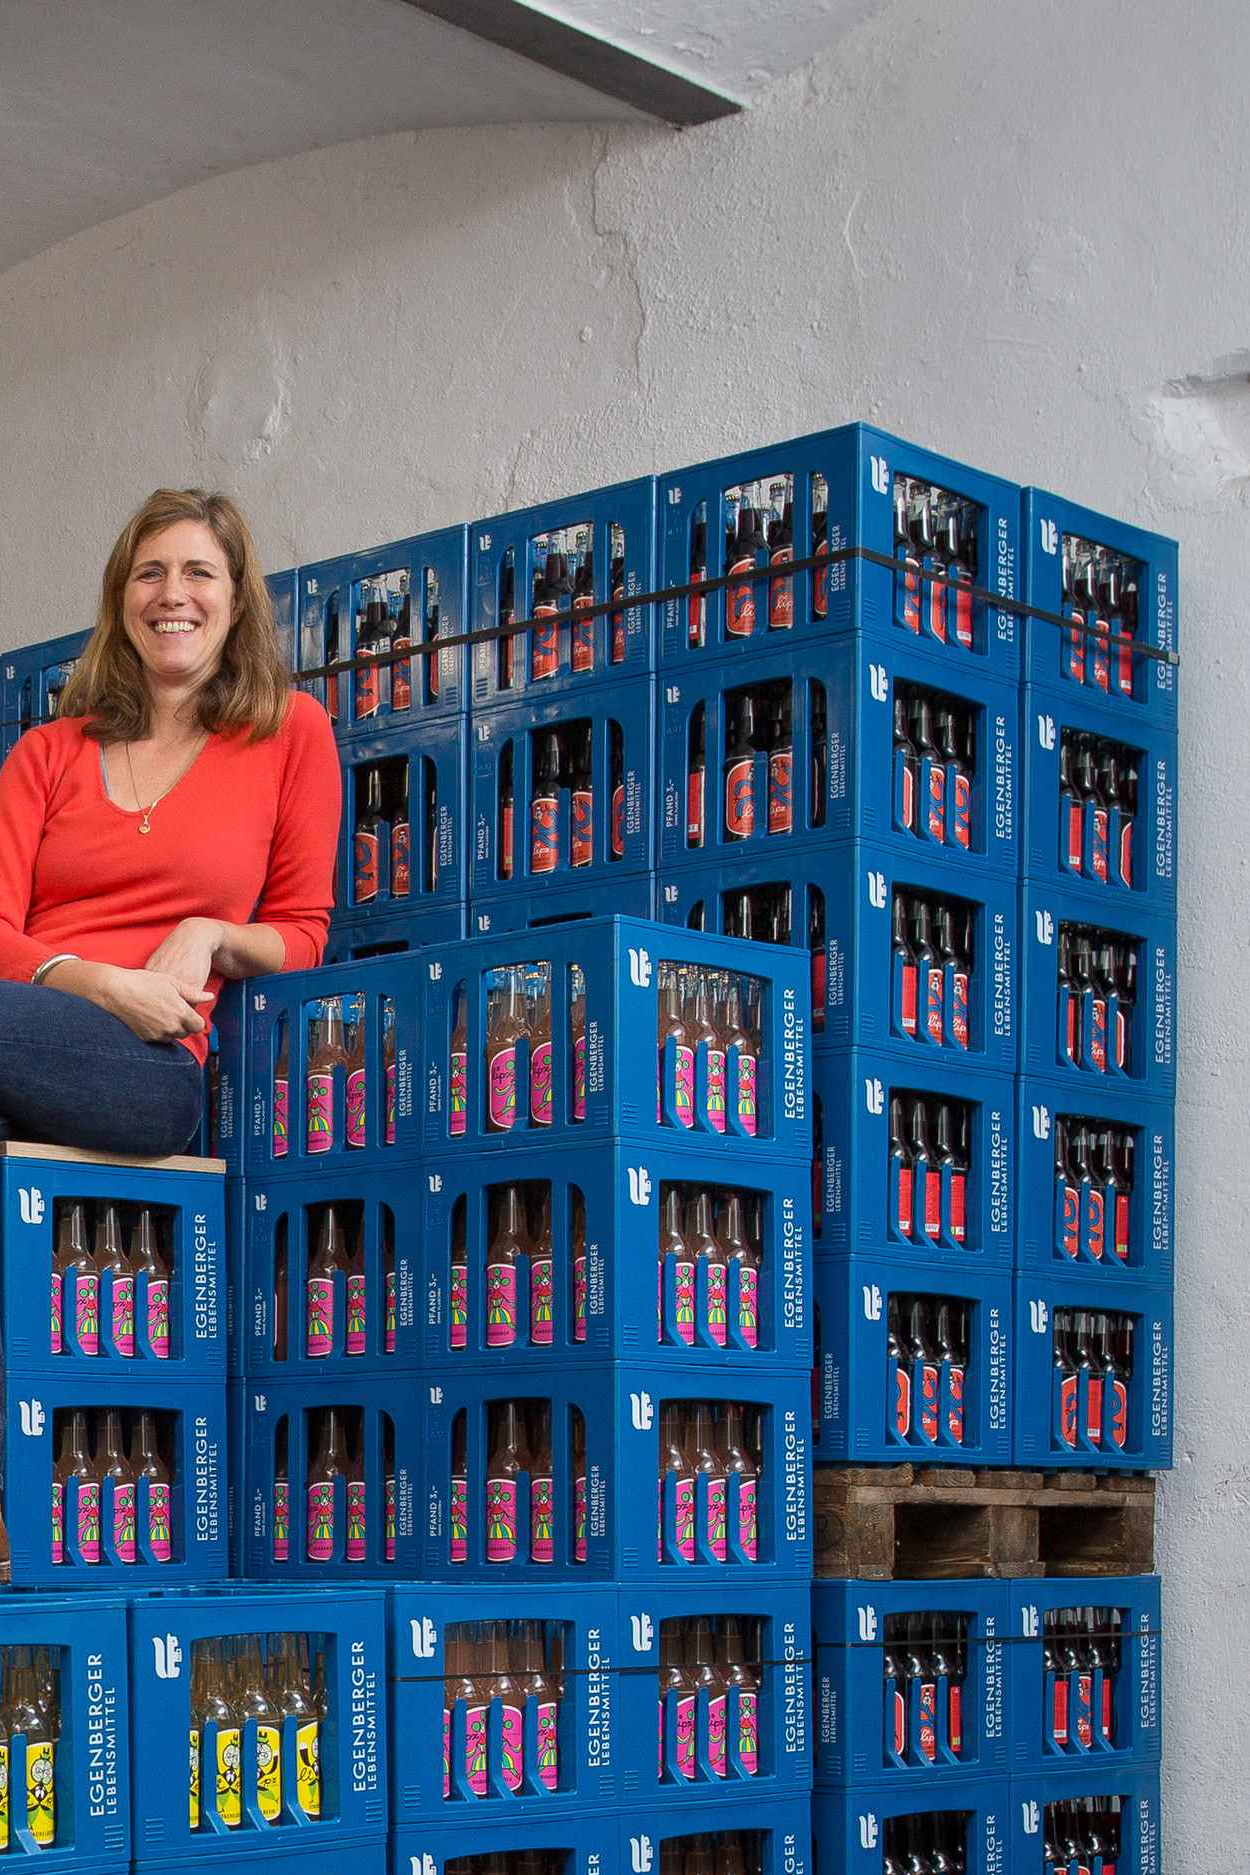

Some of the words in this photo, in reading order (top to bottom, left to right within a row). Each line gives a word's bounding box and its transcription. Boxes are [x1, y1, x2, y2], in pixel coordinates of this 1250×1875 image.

[831, 732, 839, 798] EGENBERGER
[996, 717, 1005, 838] EGENBERGER
[1157, 761, 1166, 876] EGENBERGER
[829, 940, 838, 1005] EGENBERGER
[995, 914, 1003, 1035] EGENBERGER
[1156, 948, 1164, 1062] EGENBERGER
[784, 990, 795, 1118] EGENBERGER
[796, 1019, 804, 1119] LEBENSMITTEL
[991, 1112, 1000, 1232] EGENBERGER
[1153, 1136, 1166, 1249] EGENBERGER
[195, 1215, 207, 1338] EGENBERGER
[208, 1242, 216, 1338] LEBENSMITTEL
[590, 1244, 598, 1314] EGENBERGER
[783, 1199, 794, 1327] EGENBERGER
[990, 1309, 998, 1428] EGENBERGER
[1152, 1322, 1161, 1436] EGENBERGER
[196, 1418, 208, 1540] EGENBERGER
[209, 1444, 218, 1540] LEBENSMITTEL
[785, 1412, 796, 1540] EGENBERGER
[797, 1439, 805, 1540] LEBENSMITTEL
[352, 1642, 366, 1791] EGENBERGER
[588, 1629, 600, 1766] EGENBERGER
[601, 1658, 610, 1765] LEBENSMITTEL
[784, 1624, 796, 1752] EGENBERGER
[796, 1650, 804, 1751] LEBENSMITTEL
[986, 1617, 994, 1737] EGENBERGER
[1141, 1614, 1149, 1728] EGENBERGER
[88, 1654, 104, 1816] EGENBERGER
[105, 1688, 116, 1814] LEBENSMITTEL
[366, 1672, 376, 1790] LEBENSMITTEL
